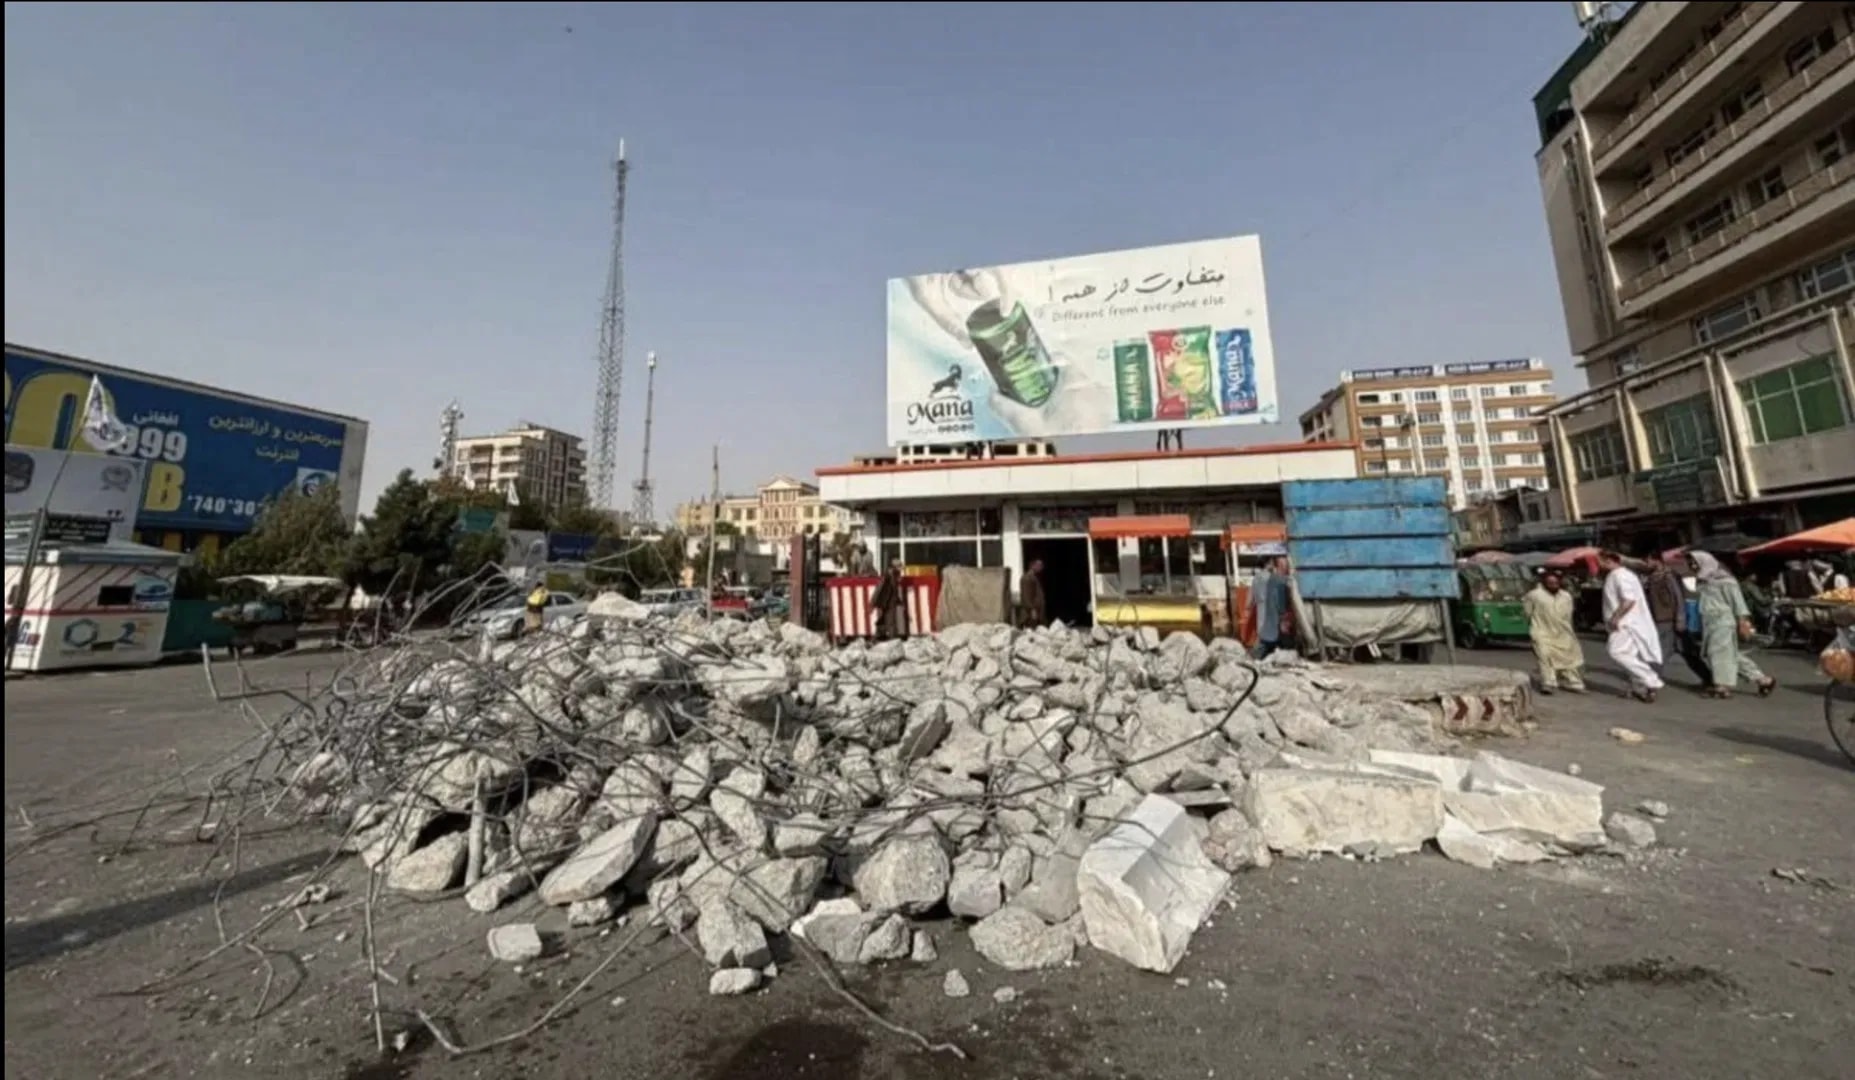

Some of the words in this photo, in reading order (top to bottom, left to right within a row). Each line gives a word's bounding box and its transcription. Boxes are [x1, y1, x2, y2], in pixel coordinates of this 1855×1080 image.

[1104, 277, 1130, 302] از
[1135, 266, 1225, 294] متفاوت
[1062, 285, 1097, 302] همه
[1052, 305, 1104, 322] Different
[1108, 302, 1139, 317] from
[1143, 298, 1197, 313] everyone
[1202, 295, 1225, 306] else
[907, 400, 974, 425] Mana
[271, 426, 282, 440] و
